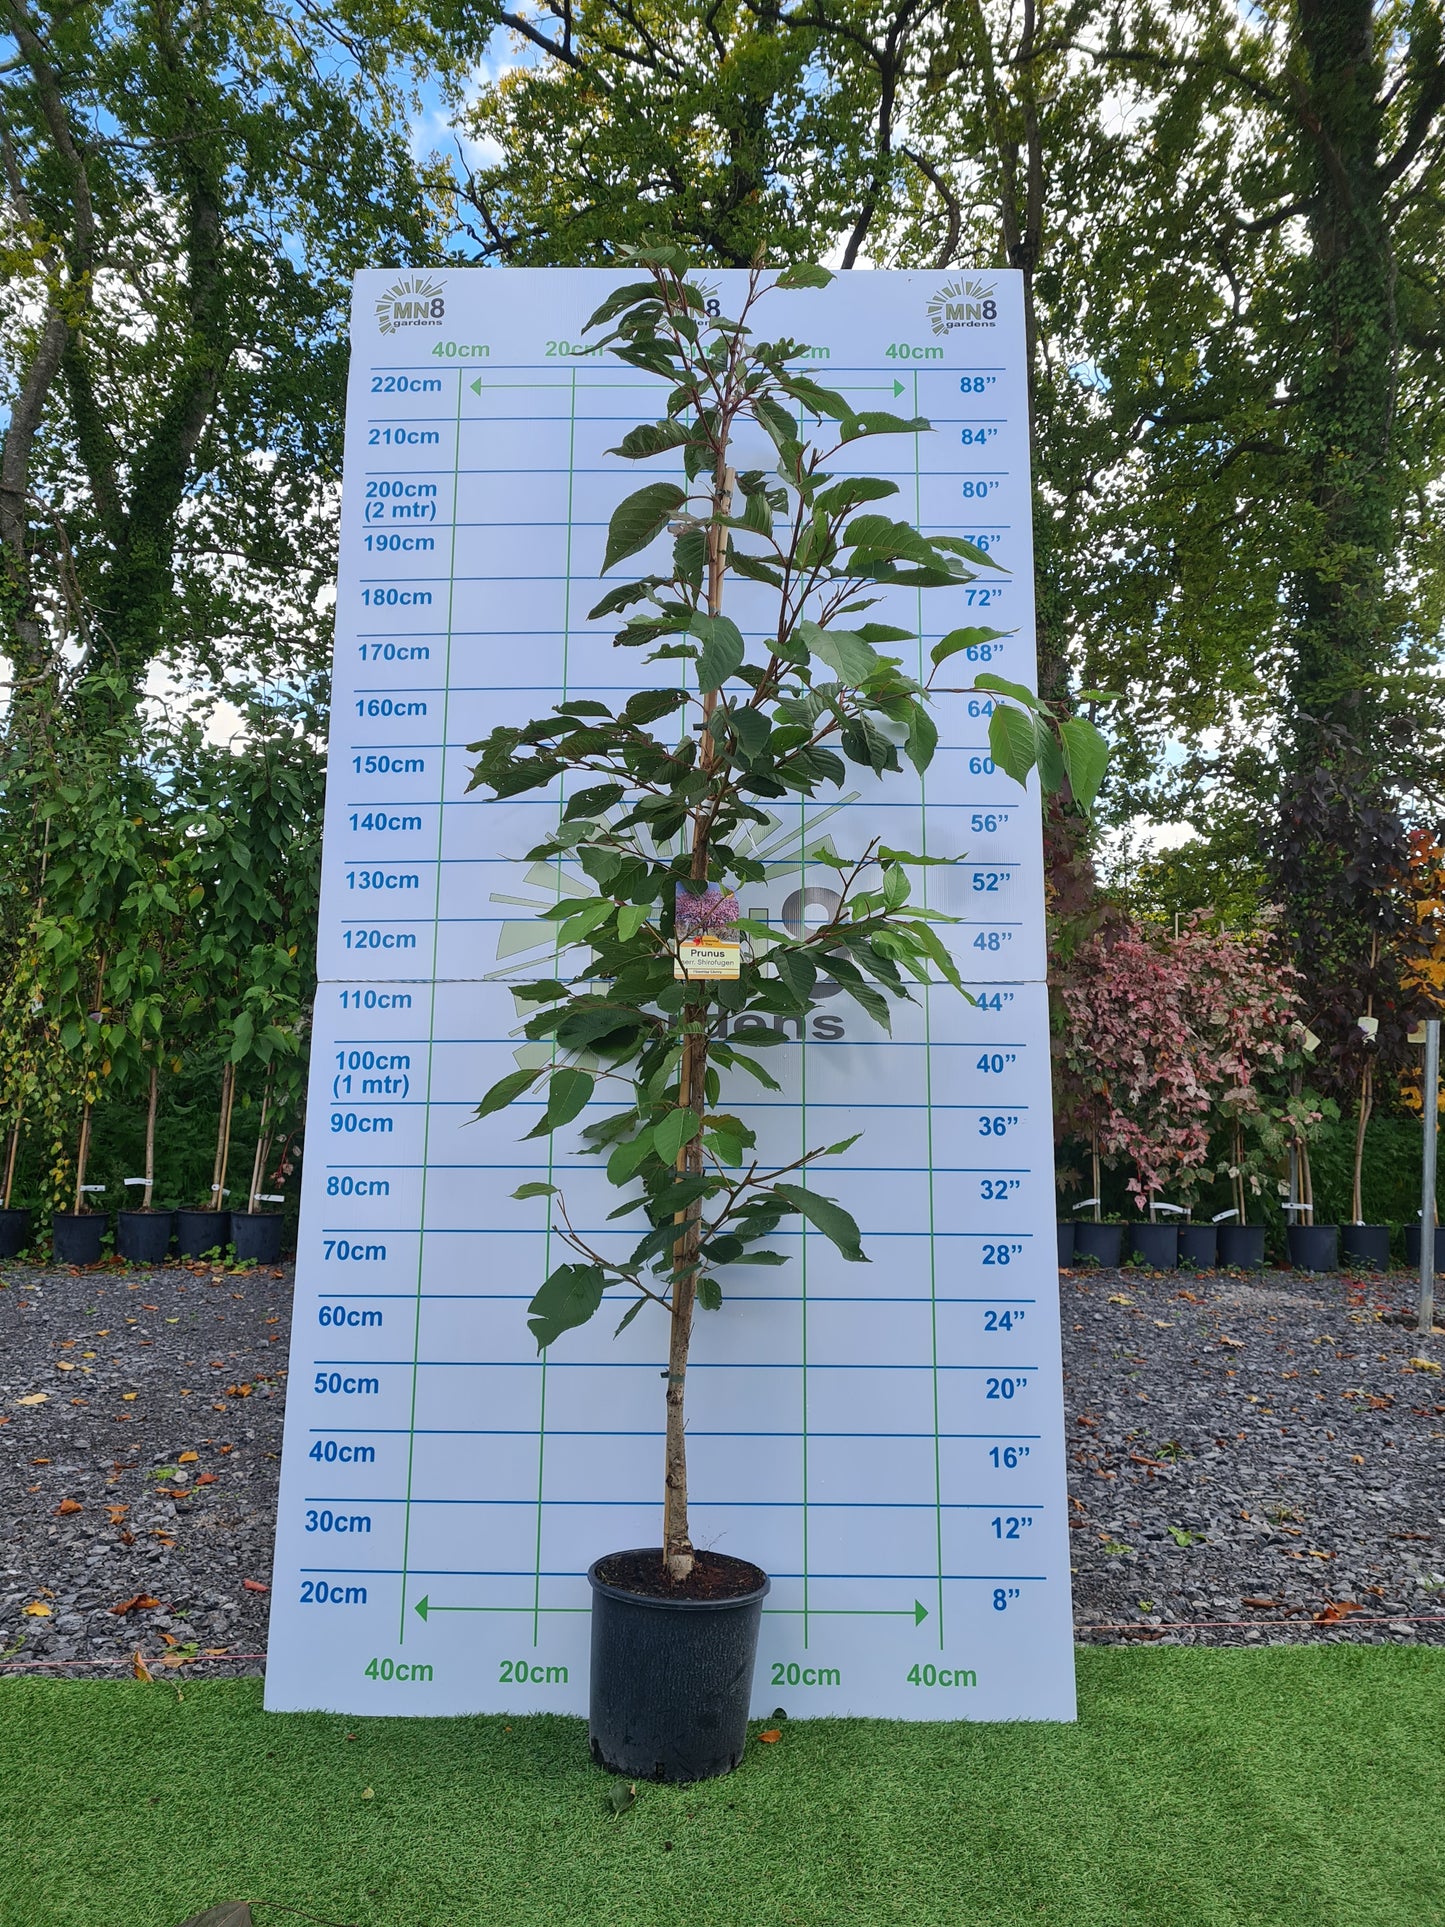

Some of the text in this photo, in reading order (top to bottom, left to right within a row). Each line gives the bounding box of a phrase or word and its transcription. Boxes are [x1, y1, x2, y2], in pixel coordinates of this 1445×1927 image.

[394, 297, 445, 319] MN8
[945, 299, 997, 321] MN8
[393, 319, 442, 328] gardens
[946, 320, 996, 329] gardens
[431, 341, 490, 358] 40cm
[885, 343, 944, 360] 40cm
[370, 375, 442, 393] 220cm
[959, 376, 996, 393] 88”
[367, 428, 440, 445] 210cm
[961, 428, 998, 446] 84”
[365, 480, 437, 498] 200cm
[962, 481, 999, 498] 80”
[364, 500, 437, 523] (2 mtr)
[364, 534, 435, 552] 190cm
[361, 588, 433, 606] 180cm
[964, 589, 1002, 607] 72”
[358, 643, 430, 661] 170cm
[355, 698, 427, 717] 160cm
[352, 755, 425, 774] 150cm
[968, 756, 996, 775] 60
[349, 812, 422, 832] 140cm
[971, 814, 1009, 833] 56”
[345, 870, 419, 890] 130cm
[972, 872, 1011, 892] 52”
[342, 929, 416, 949] 120cm
[973, 932, 1012, 952] 48”
[690, 949, 725, 958] Prunus
[697, 959, 735, 968] Shirofugen
[339, 989, 412, 1009] 110cm
[335, 1050, 411, 1071] 100cm
[976, 1053, 1016, 1074] 40”
[332, 1073, 410, 1100] (1 mtr)
[330, 1112, 393, 1133] 90cm
[978, 1116, 1018, 1137] 36”
[326, 1175, 390, 1196] 80cm
[980, 1179, 1020, 1200] 32”
[323, 1240, 387, 1261] 70cm
[982, 1244, 1023, 1266] 28”
[318, 1305, 383, 1327] 60cm
[984, 1310, 1025, 1332] 24”
[314, 1372, 379, 1394] 50cm
[985, 1377, 1027, 1400] 20”
[308, 1440, 375, 1463] 40cm
[989, 1446, 1030, 1469] 16”
[304, 1509, 372, 1533] 30cm
[991, 1516, 1033, 1539] 12”
[299, 1580, 368, 1605] 20cm
[992, 1588, 1020, 1612] 8”
[364, 1657, 434, 1682] 40cm
[498, 1660, 569, 1684] 20cm
[770, 1662, 841, 1686] 20cm
[906, 1663, 977, 1687] 40cm
